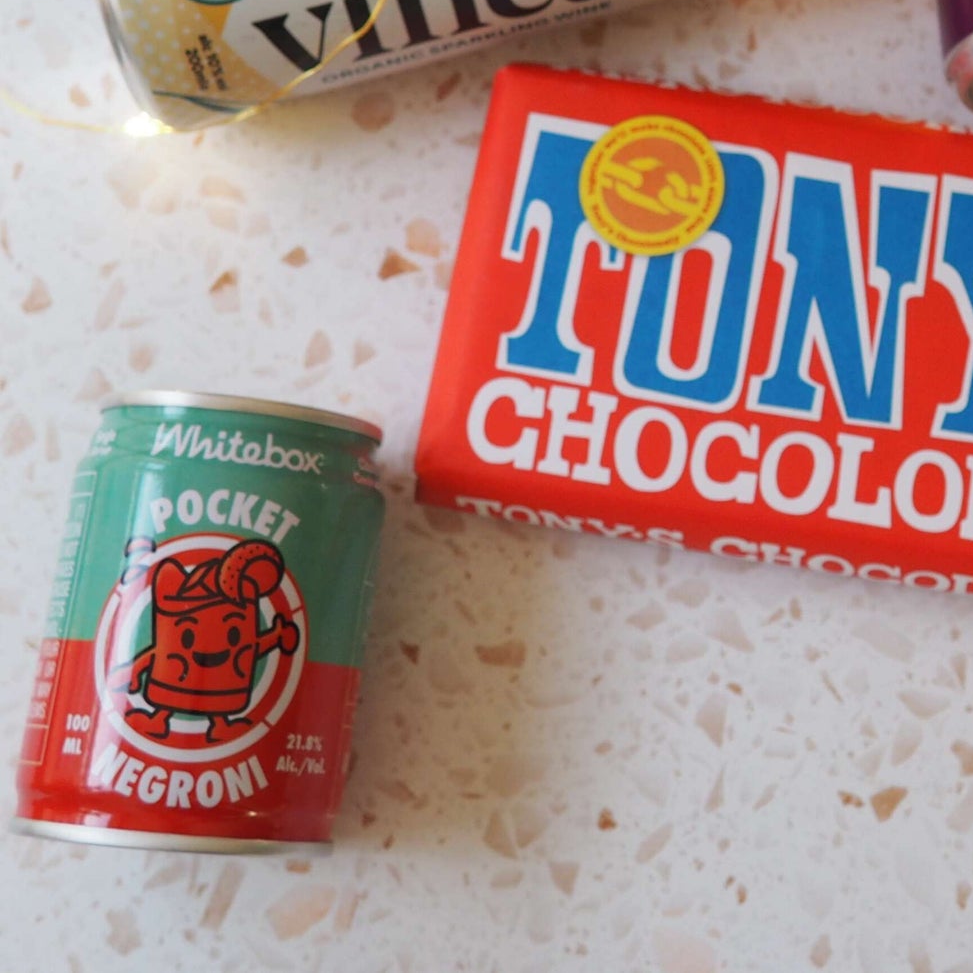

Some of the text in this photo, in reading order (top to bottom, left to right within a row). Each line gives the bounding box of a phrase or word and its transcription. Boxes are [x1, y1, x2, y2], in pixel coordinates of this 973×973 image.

[321, 49, 426, 84] ORGANIC
[428, 15, 549, 55] SPARKLING
[150, 422, 321, 475] Whitebox
[151, 488, 301, 545] POCKET
[62, 737, 83, 756] ML
[66, 714, 92, 732] 100
[286, 733, 323, 752] 21.8%
[87, 741, 269, 810] NEGRONI
